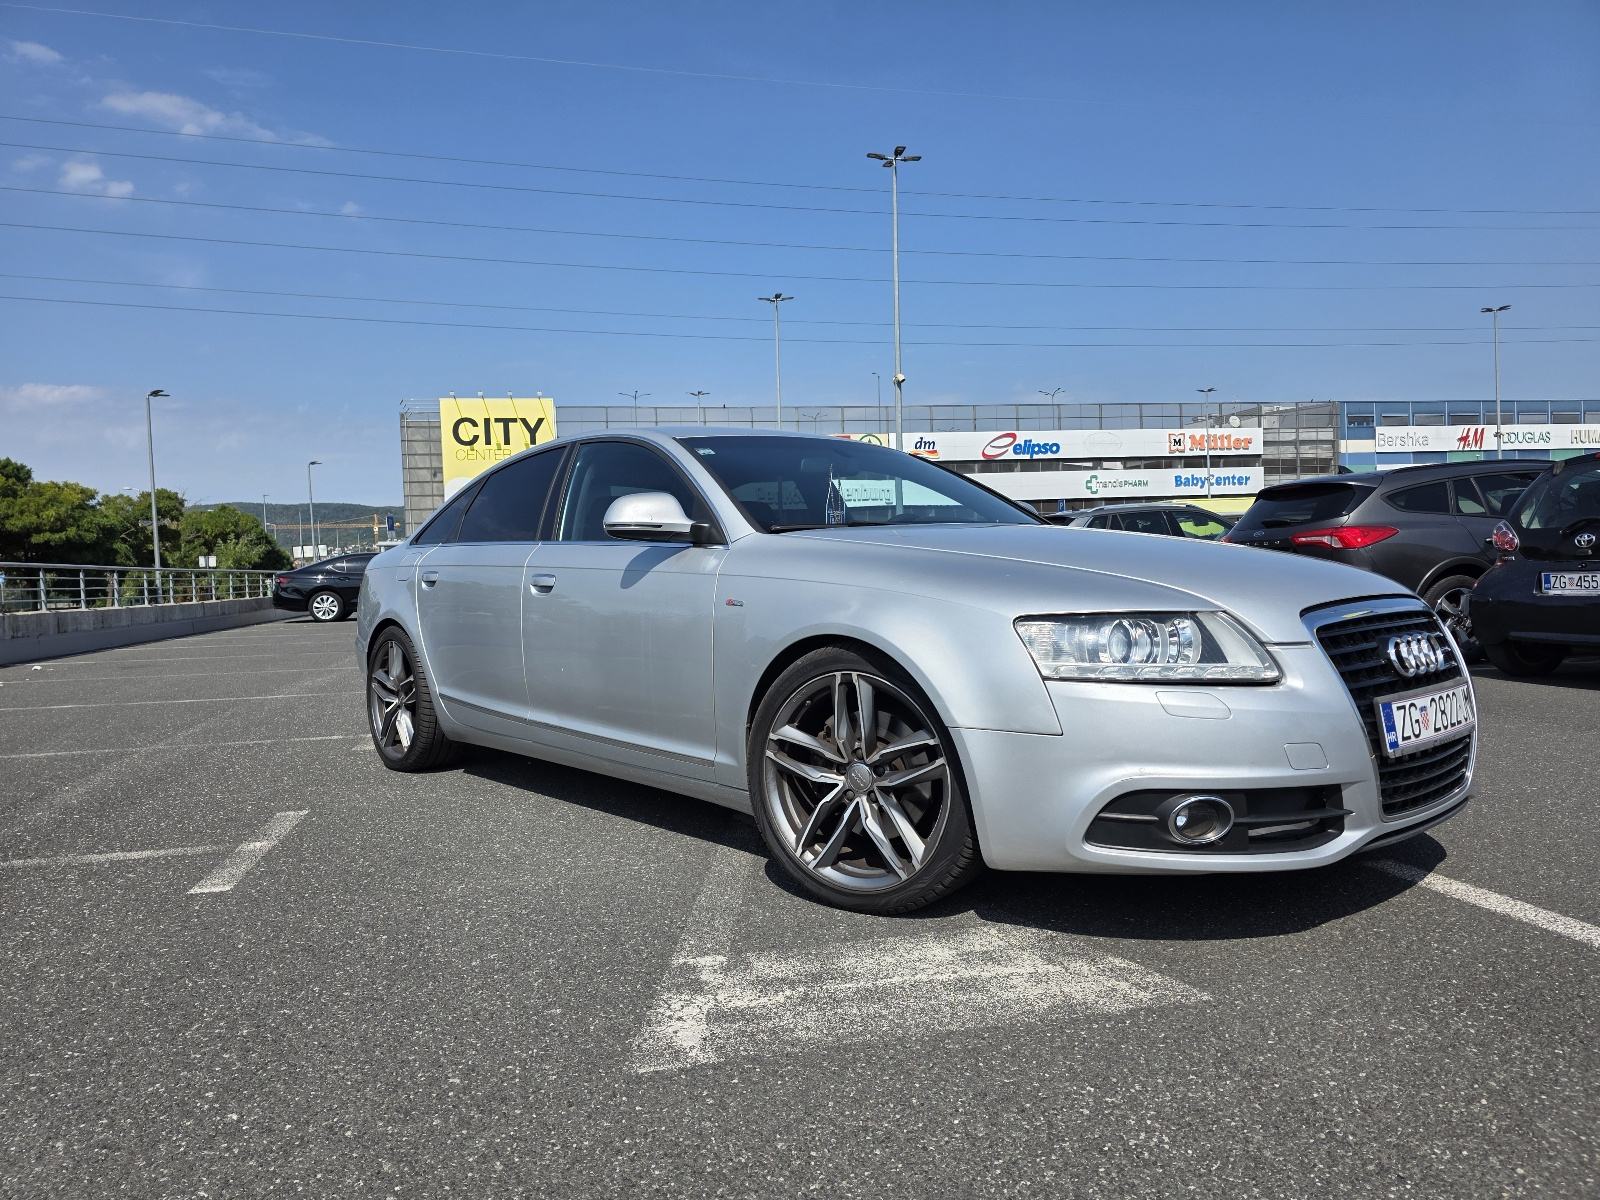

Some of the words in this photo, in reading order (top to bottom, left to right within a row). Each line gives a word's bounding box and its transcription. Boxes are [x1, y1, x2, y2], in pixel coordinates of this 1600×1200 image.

[452, 417, 545, 446] CITY
[1457, 427, 1486, 450] H&M
[1502, 431, 1551, 444] DOUGLAS
[915, 436, 936, 450] dm
[1377, 432, 1430, 447] Bershka
[455, 449, 512, 461] CENTER
[1013, 439, 1060, 459] elipso
[844, 487, 894, 504] enburg
[1551, 575, 1567, 589] ZG
[1396, 702, 1421, 741] ZG
[1386, 731, 1397, 743] HR
